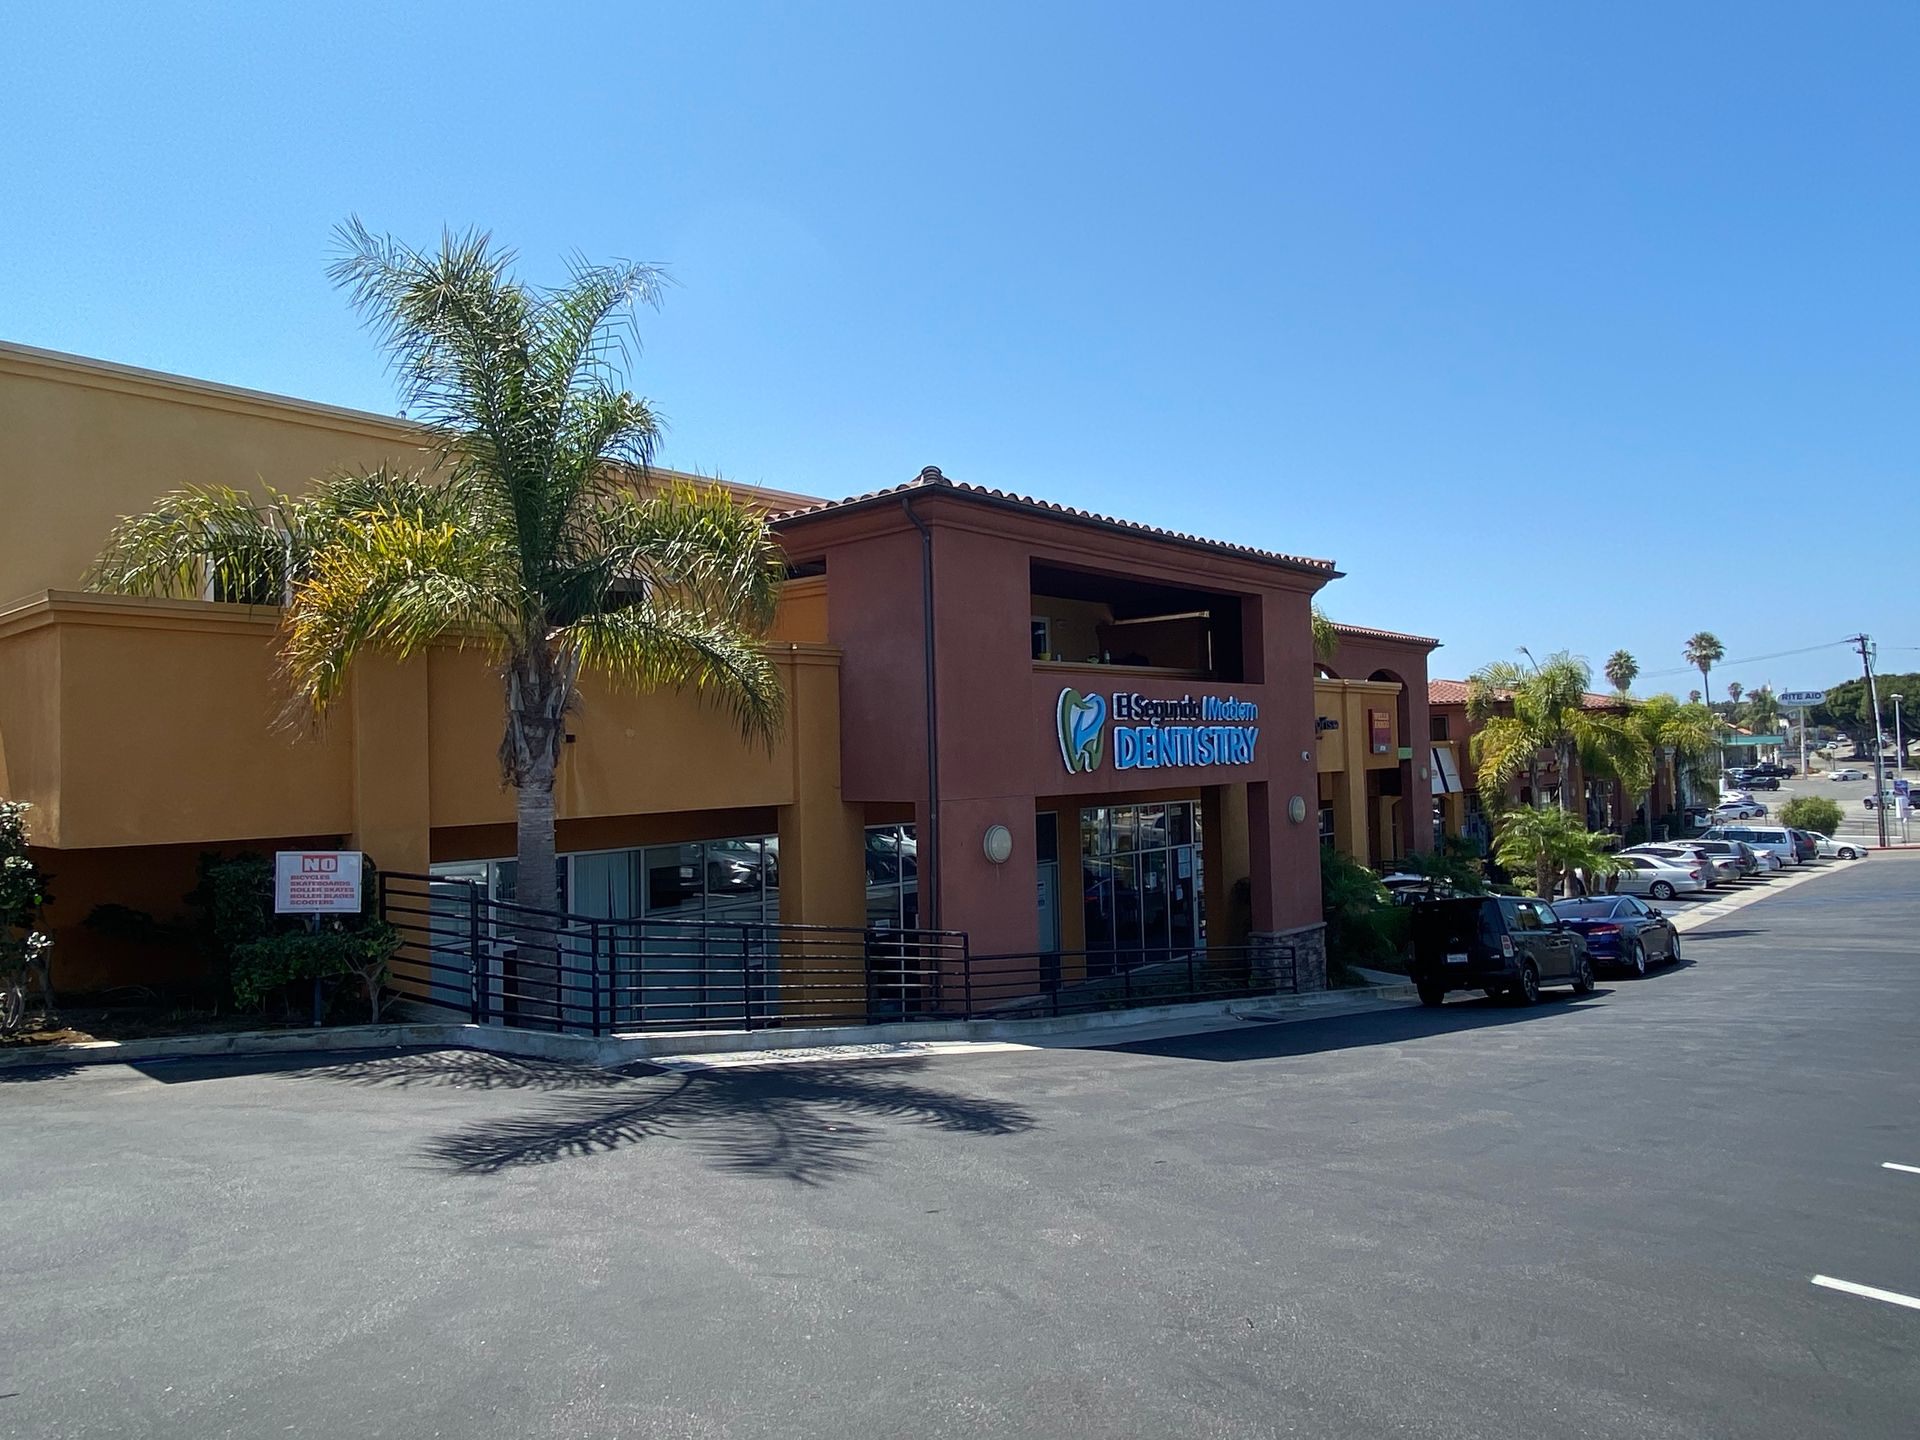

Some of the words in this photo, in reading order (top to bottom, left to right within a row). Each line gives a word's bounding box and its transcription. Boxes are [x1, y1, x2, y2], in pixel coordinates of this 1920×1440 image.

[1130, 693, 1202, 727] Segundo
[1202, 695, 1259, 721] Modern
[1114, 727, 1259, 769] DENTISTRY
[303, 858, 337, 871] NO
